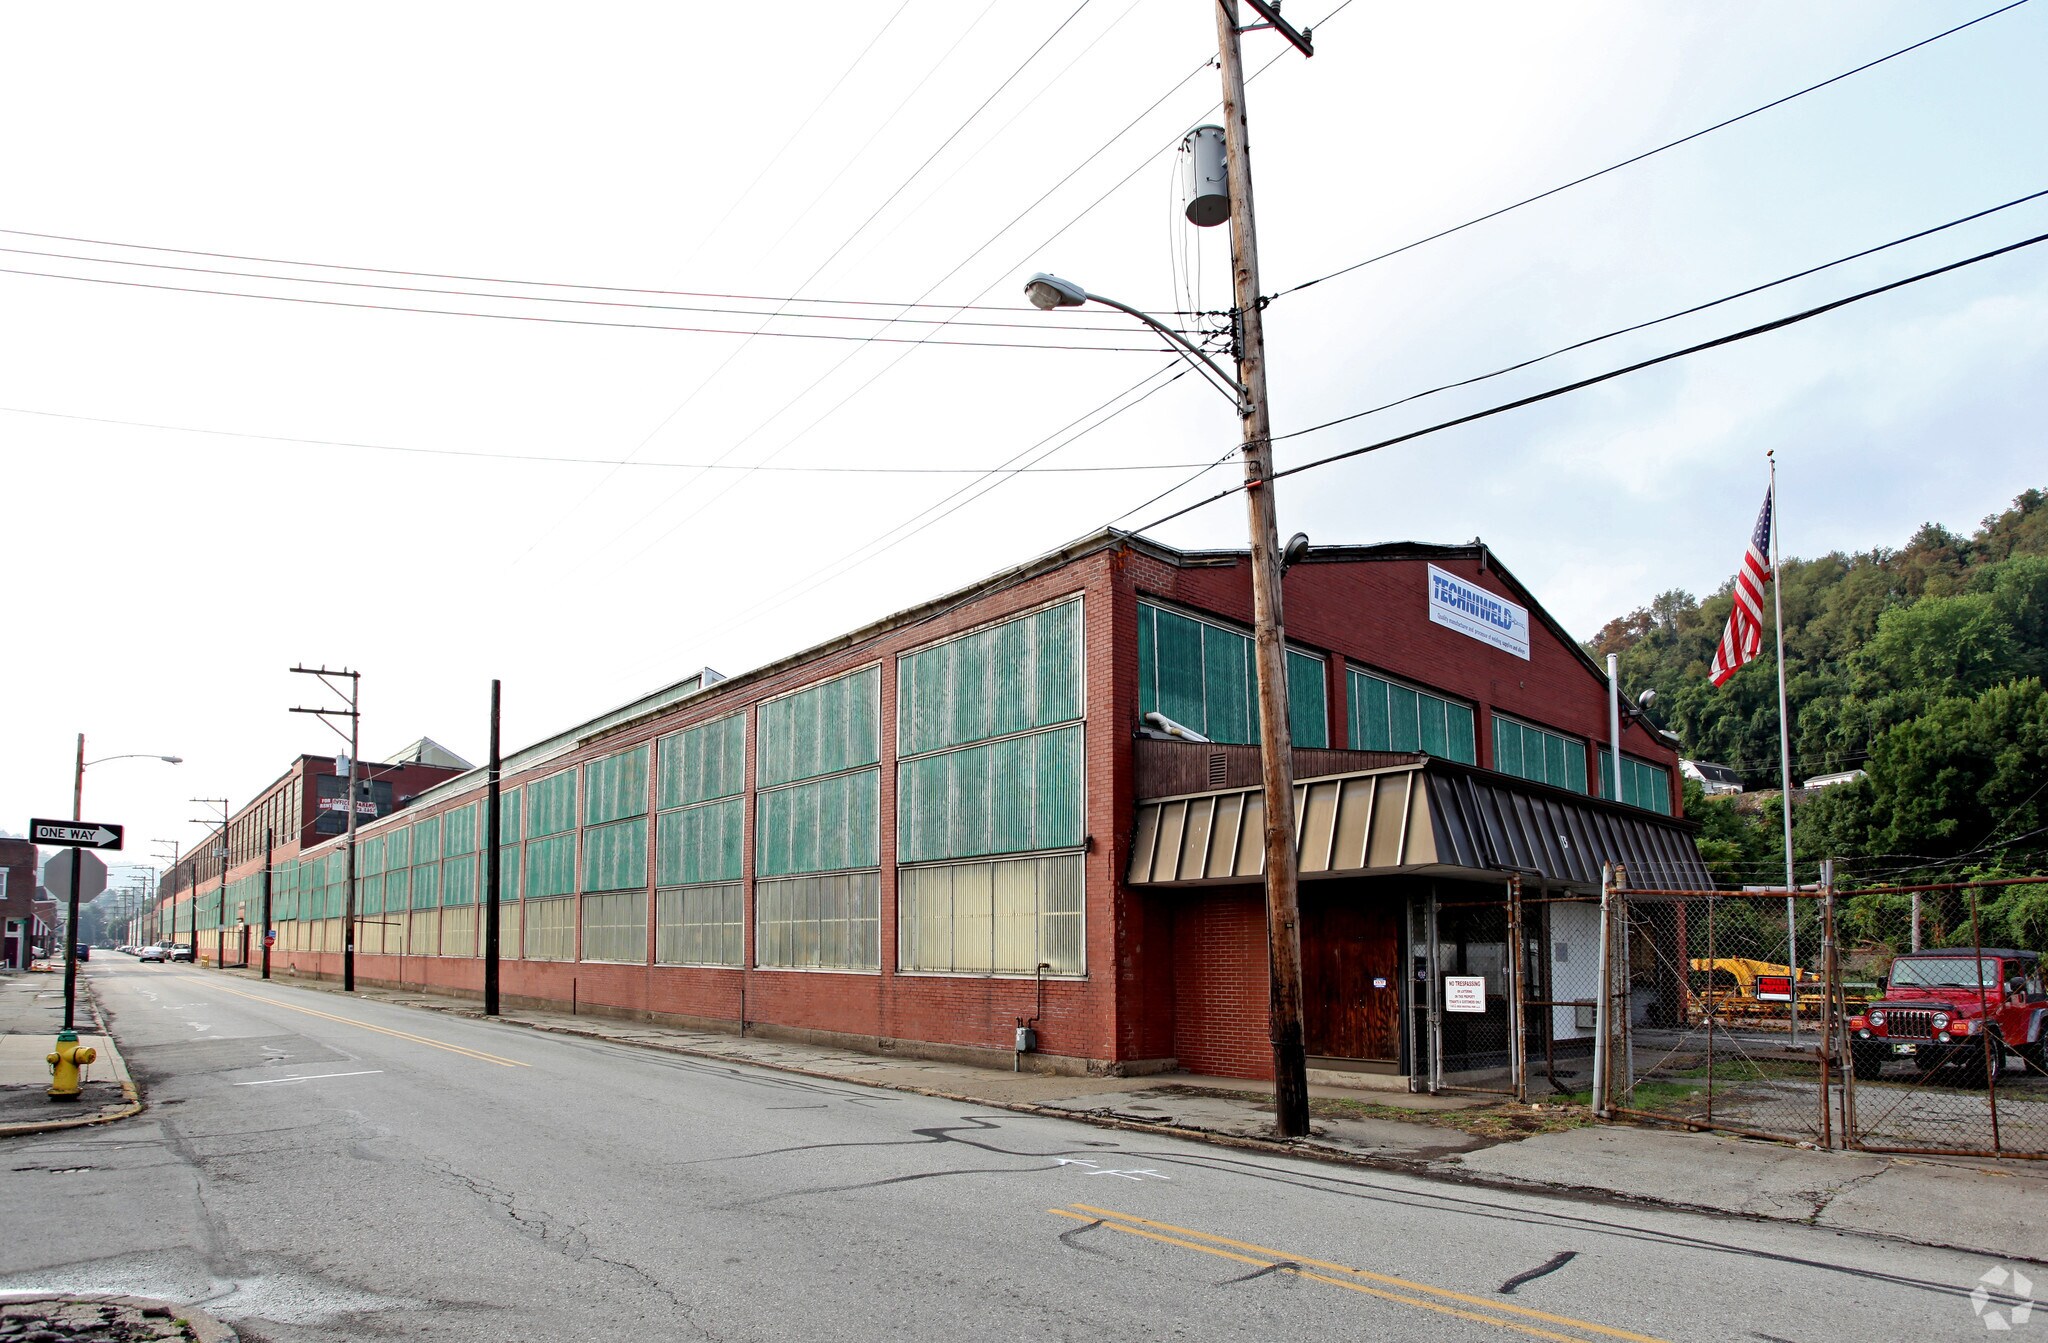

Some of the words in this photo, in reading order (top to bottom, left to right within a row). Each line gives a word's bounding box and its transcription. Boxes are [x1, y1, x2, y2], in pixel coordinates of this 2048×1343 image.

[1433, 575, 1512, 630] TECHNIWELD
[40, 827, 66, 838] ONE
[70, 829, 96, 840] WAY
[1760, 984, 1790, 992] PROPERTY
